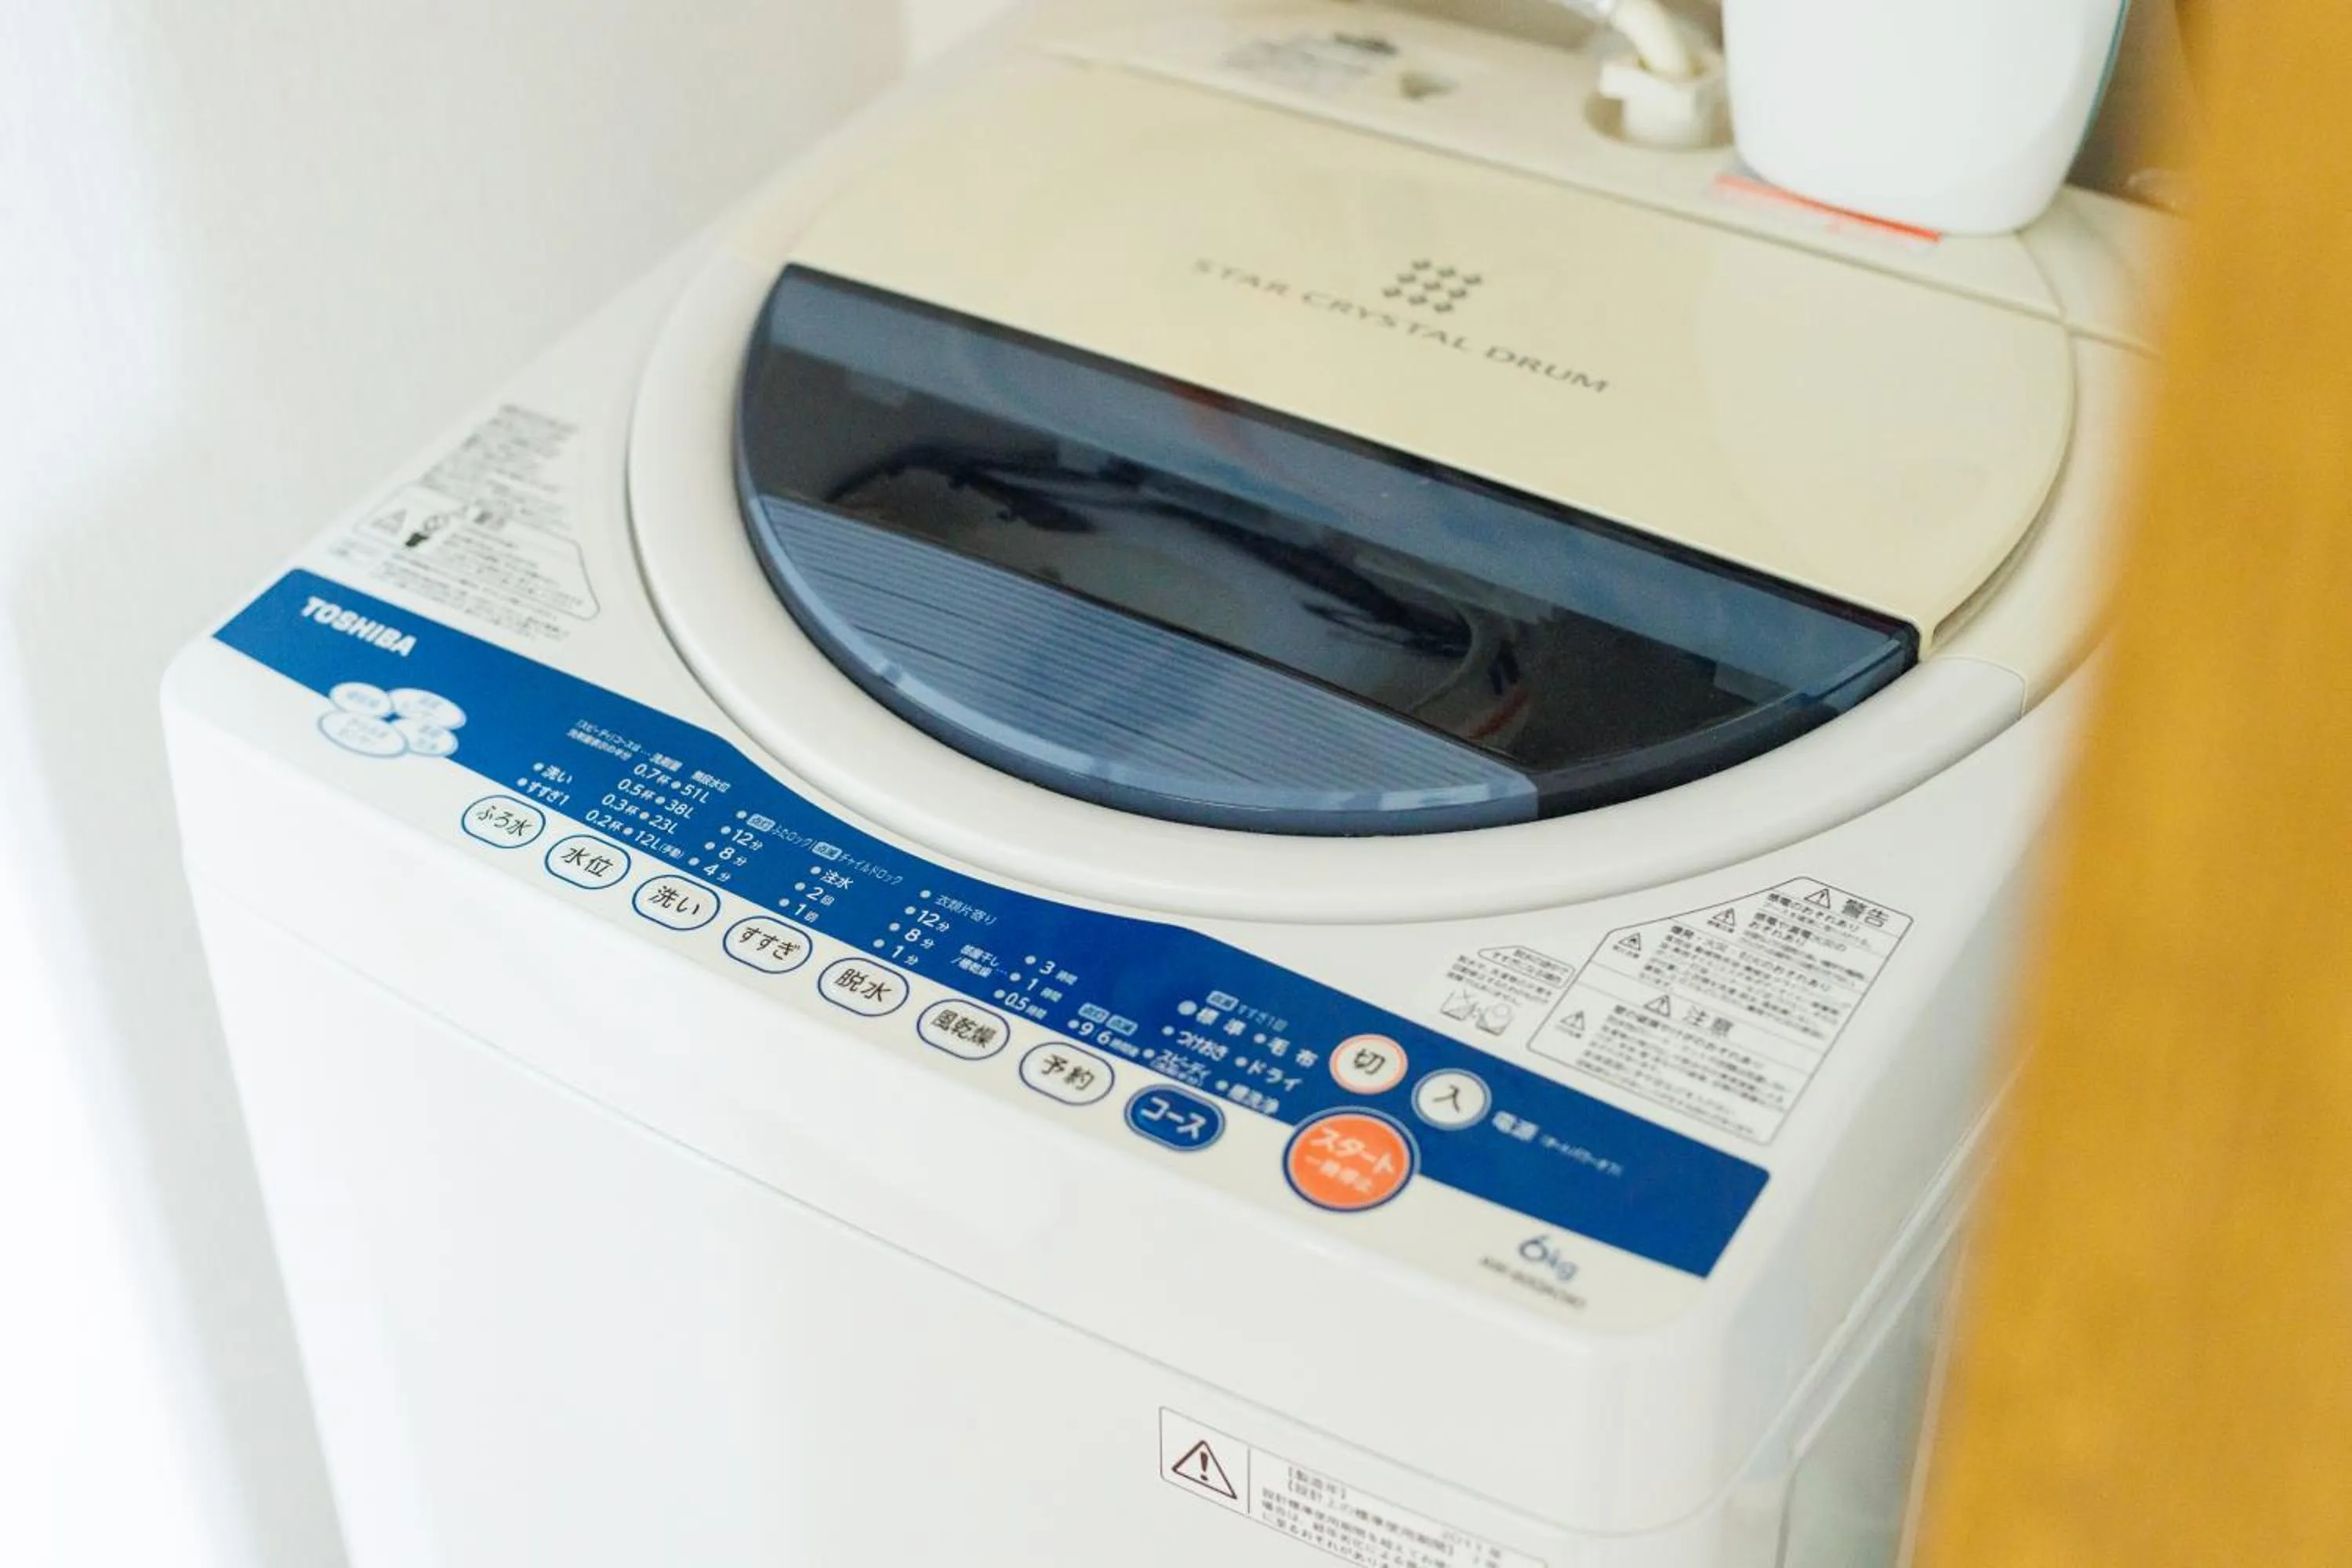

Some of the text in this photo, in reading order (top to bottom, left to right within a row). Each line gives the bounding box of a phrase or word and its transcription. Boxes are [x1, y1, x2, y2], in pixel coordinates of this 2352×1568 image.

[1192, 258, 1610, 394] STAR CRYSTAL DRUM
[301, 596, 416, 656] TOSHIBA
[477, 805, 532, 837] ふろ水
[665, 799, 695, 819] 38L
[648, 815, 678, 835] 23L
[561, 846, 614, 877] 水位
[820, 869, 853, 890] 注水
[648, 884, 700, 915] 洗い
[1842, 898, 1889, 927] 警告
[916, 909, 950, 933] 12分
[739, 927, 801, 960] すすぎ
[834, 968, 891, 1003] 脱水
[930, 1009, 997, 1048] 風乾燥
[1683, 1006, 1735, 1037] 注意
[1040, 1054, 1095, 1091] 予約
[1247, 1059, 1303, 1092] ドライ
[1353, 1047, 1386, 1076] 切
[1432, 1083, 1462, 1113] 入
[1141, 1097, 1207, 1140] コース
[1309, 1125, 1396, 1175] スタート
